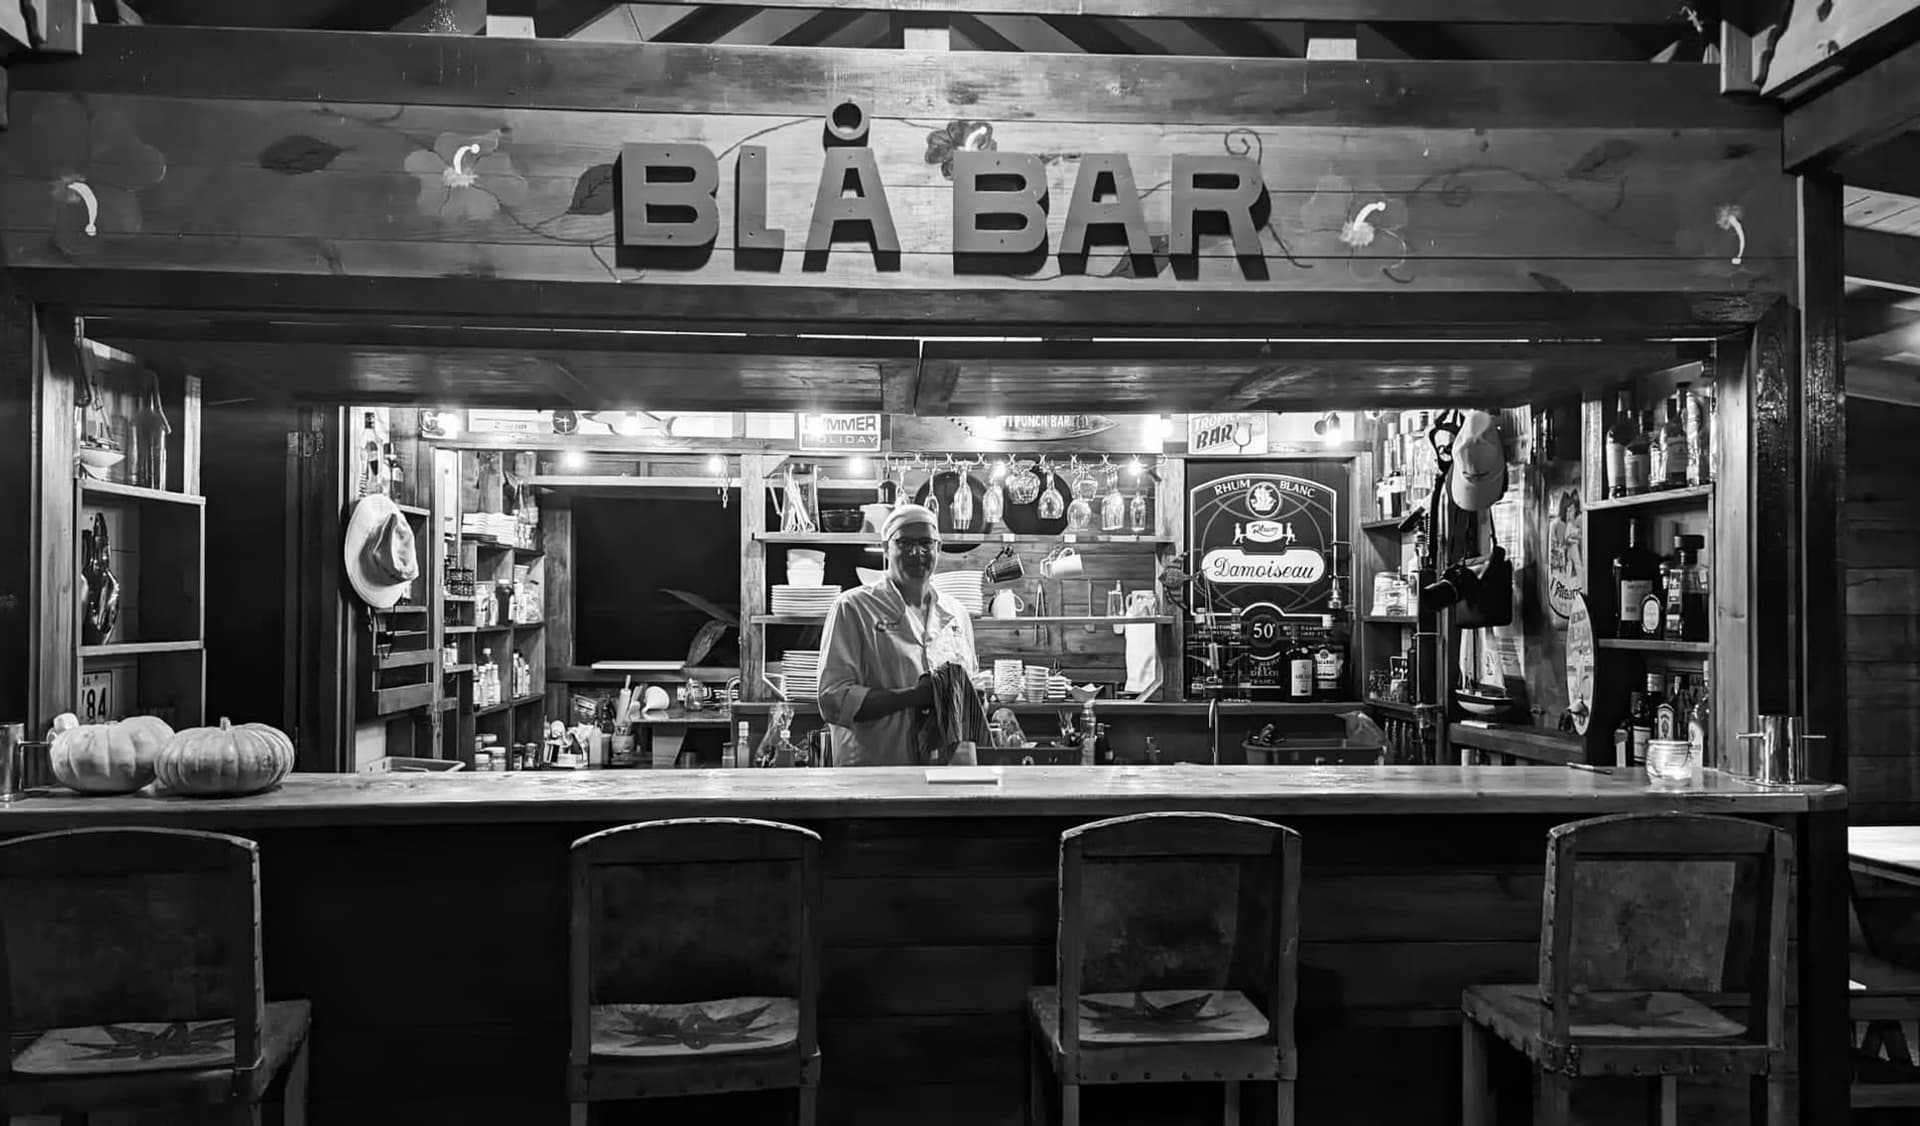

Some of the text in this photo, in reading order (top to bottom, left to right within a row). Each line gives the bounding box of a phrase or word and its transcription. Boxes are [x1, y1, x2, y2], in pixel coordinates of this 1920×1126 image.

[622, 102, 1263, 255] BLÅ BAR
[804, 414, 877, 432] MMER
[804, 434, 876, 445] OLIDAY
[1196, 423, 1233, 449] BAR
[1213, 479, 1317, 498] RHUM BLANC
[1213, 556, 1315, 579] Damoiseau
